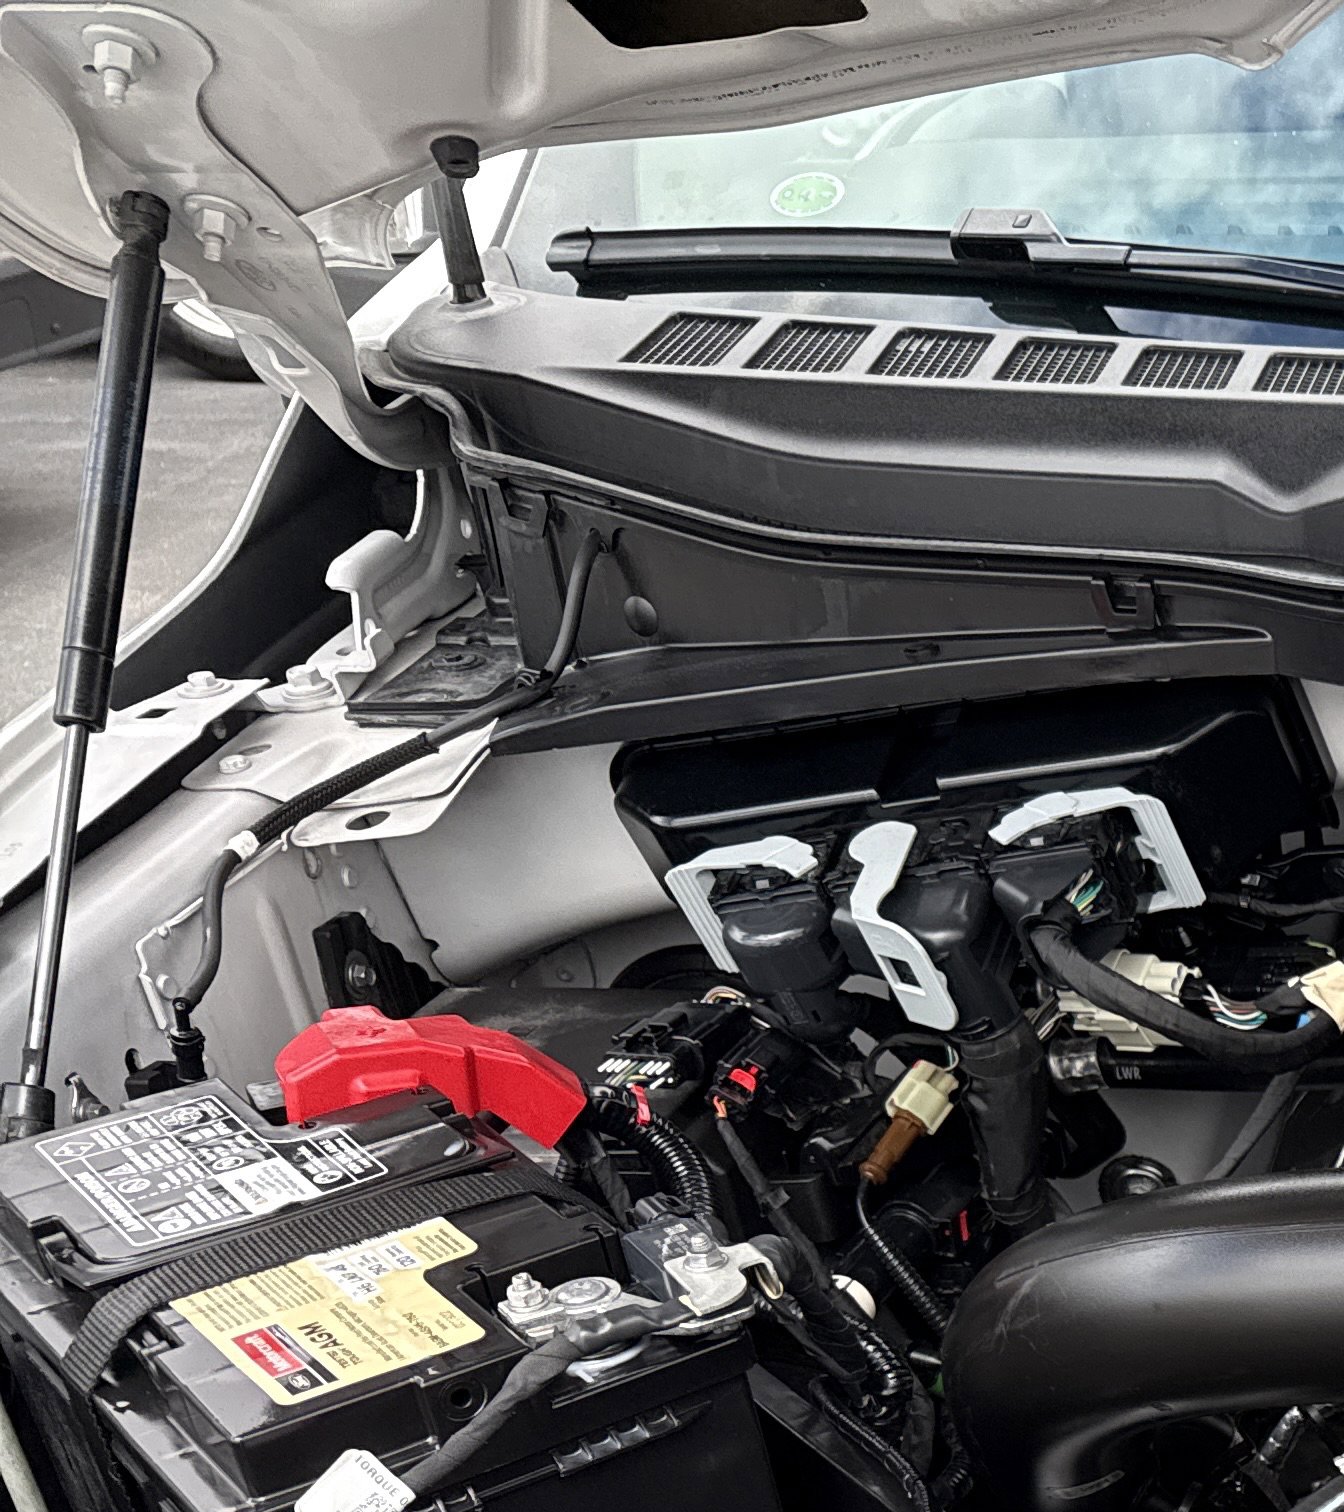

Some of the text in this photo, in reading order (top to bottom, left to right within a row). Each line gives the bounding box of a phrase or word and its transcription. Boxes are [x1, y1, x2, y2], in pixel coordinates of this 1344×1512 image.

[1115, 1066, 1142, 1080] LWR
[239, 1332, 297, 1372] Motorcraft
[295, 1319, 345, 1352] AGM
